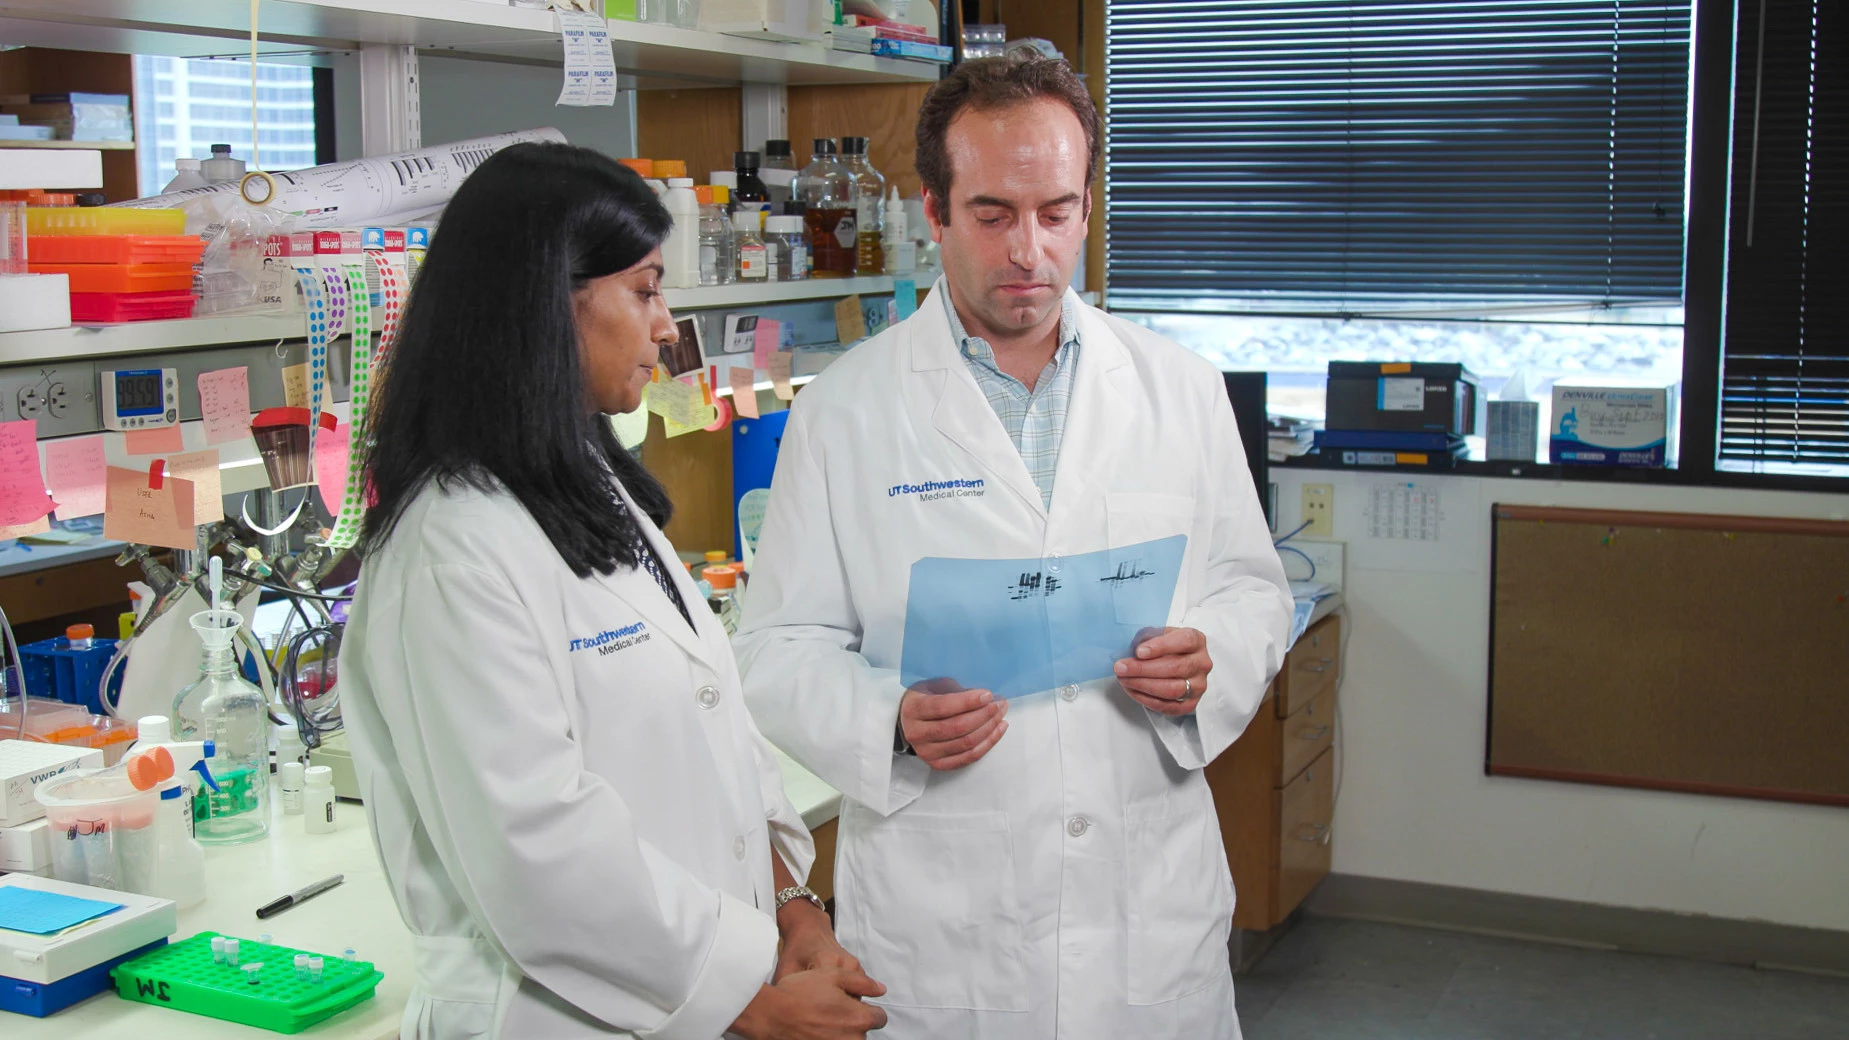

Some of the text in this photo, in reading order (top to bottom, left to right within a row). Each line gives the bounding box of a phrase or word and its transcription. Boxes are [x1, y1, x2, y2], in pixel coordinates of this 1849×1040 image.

[263, 243, 281, 256] POTS
[264, 295, 282, 303] USA
[1562, 391, 1606, 400] DENVILLE
[888, 478, 985, 497] UT Southwestern
[920, 489, 985, 502] Medical Center
[582, 621, 646, 649] Southwestern
[597, 632, 651, 657] Medical Center
